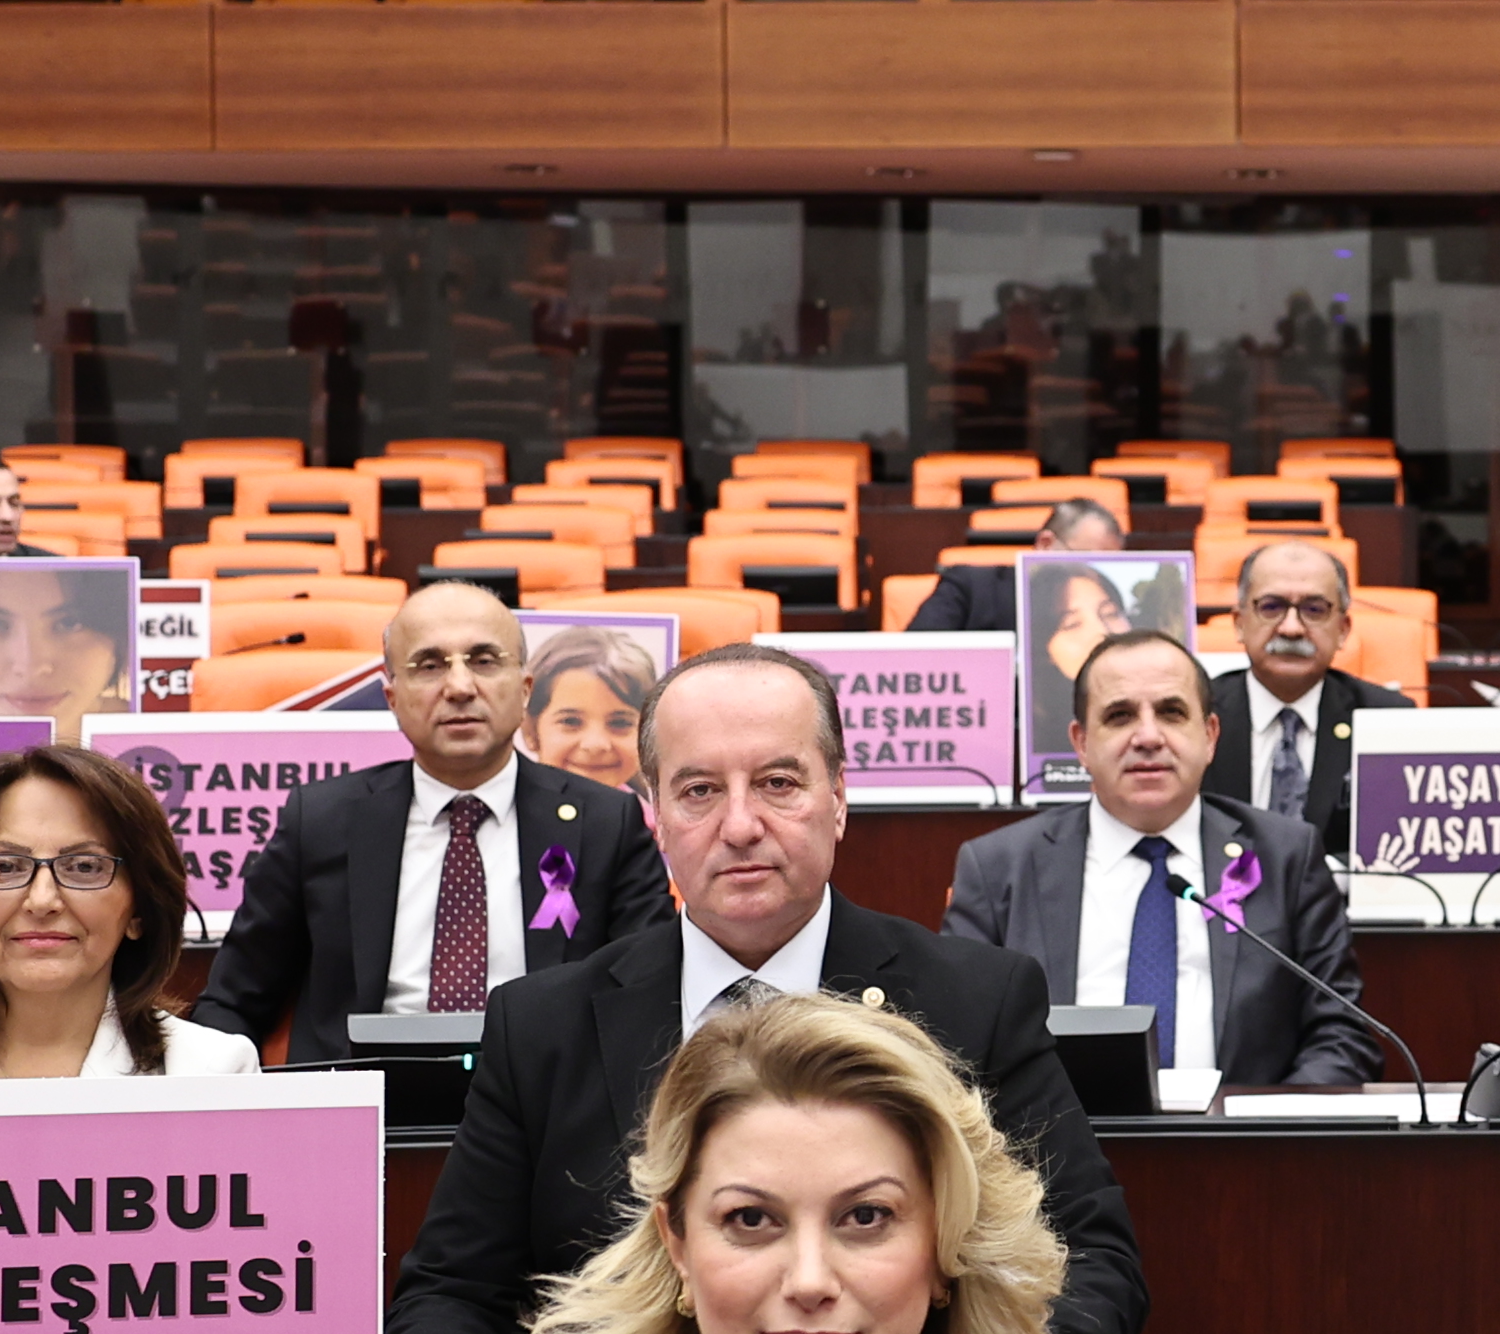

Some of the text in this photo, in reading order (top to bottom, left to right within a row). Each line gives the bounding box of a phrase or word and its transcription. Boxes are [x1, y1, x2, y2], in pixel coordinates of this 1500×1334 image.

[140, 613, 199, 638] EĞİL
[834, 672, 967, 695] TANBUL
[844, 699, 986, 736] LEŞMESİ
[849, 740, 956, 770] ŞATIR
